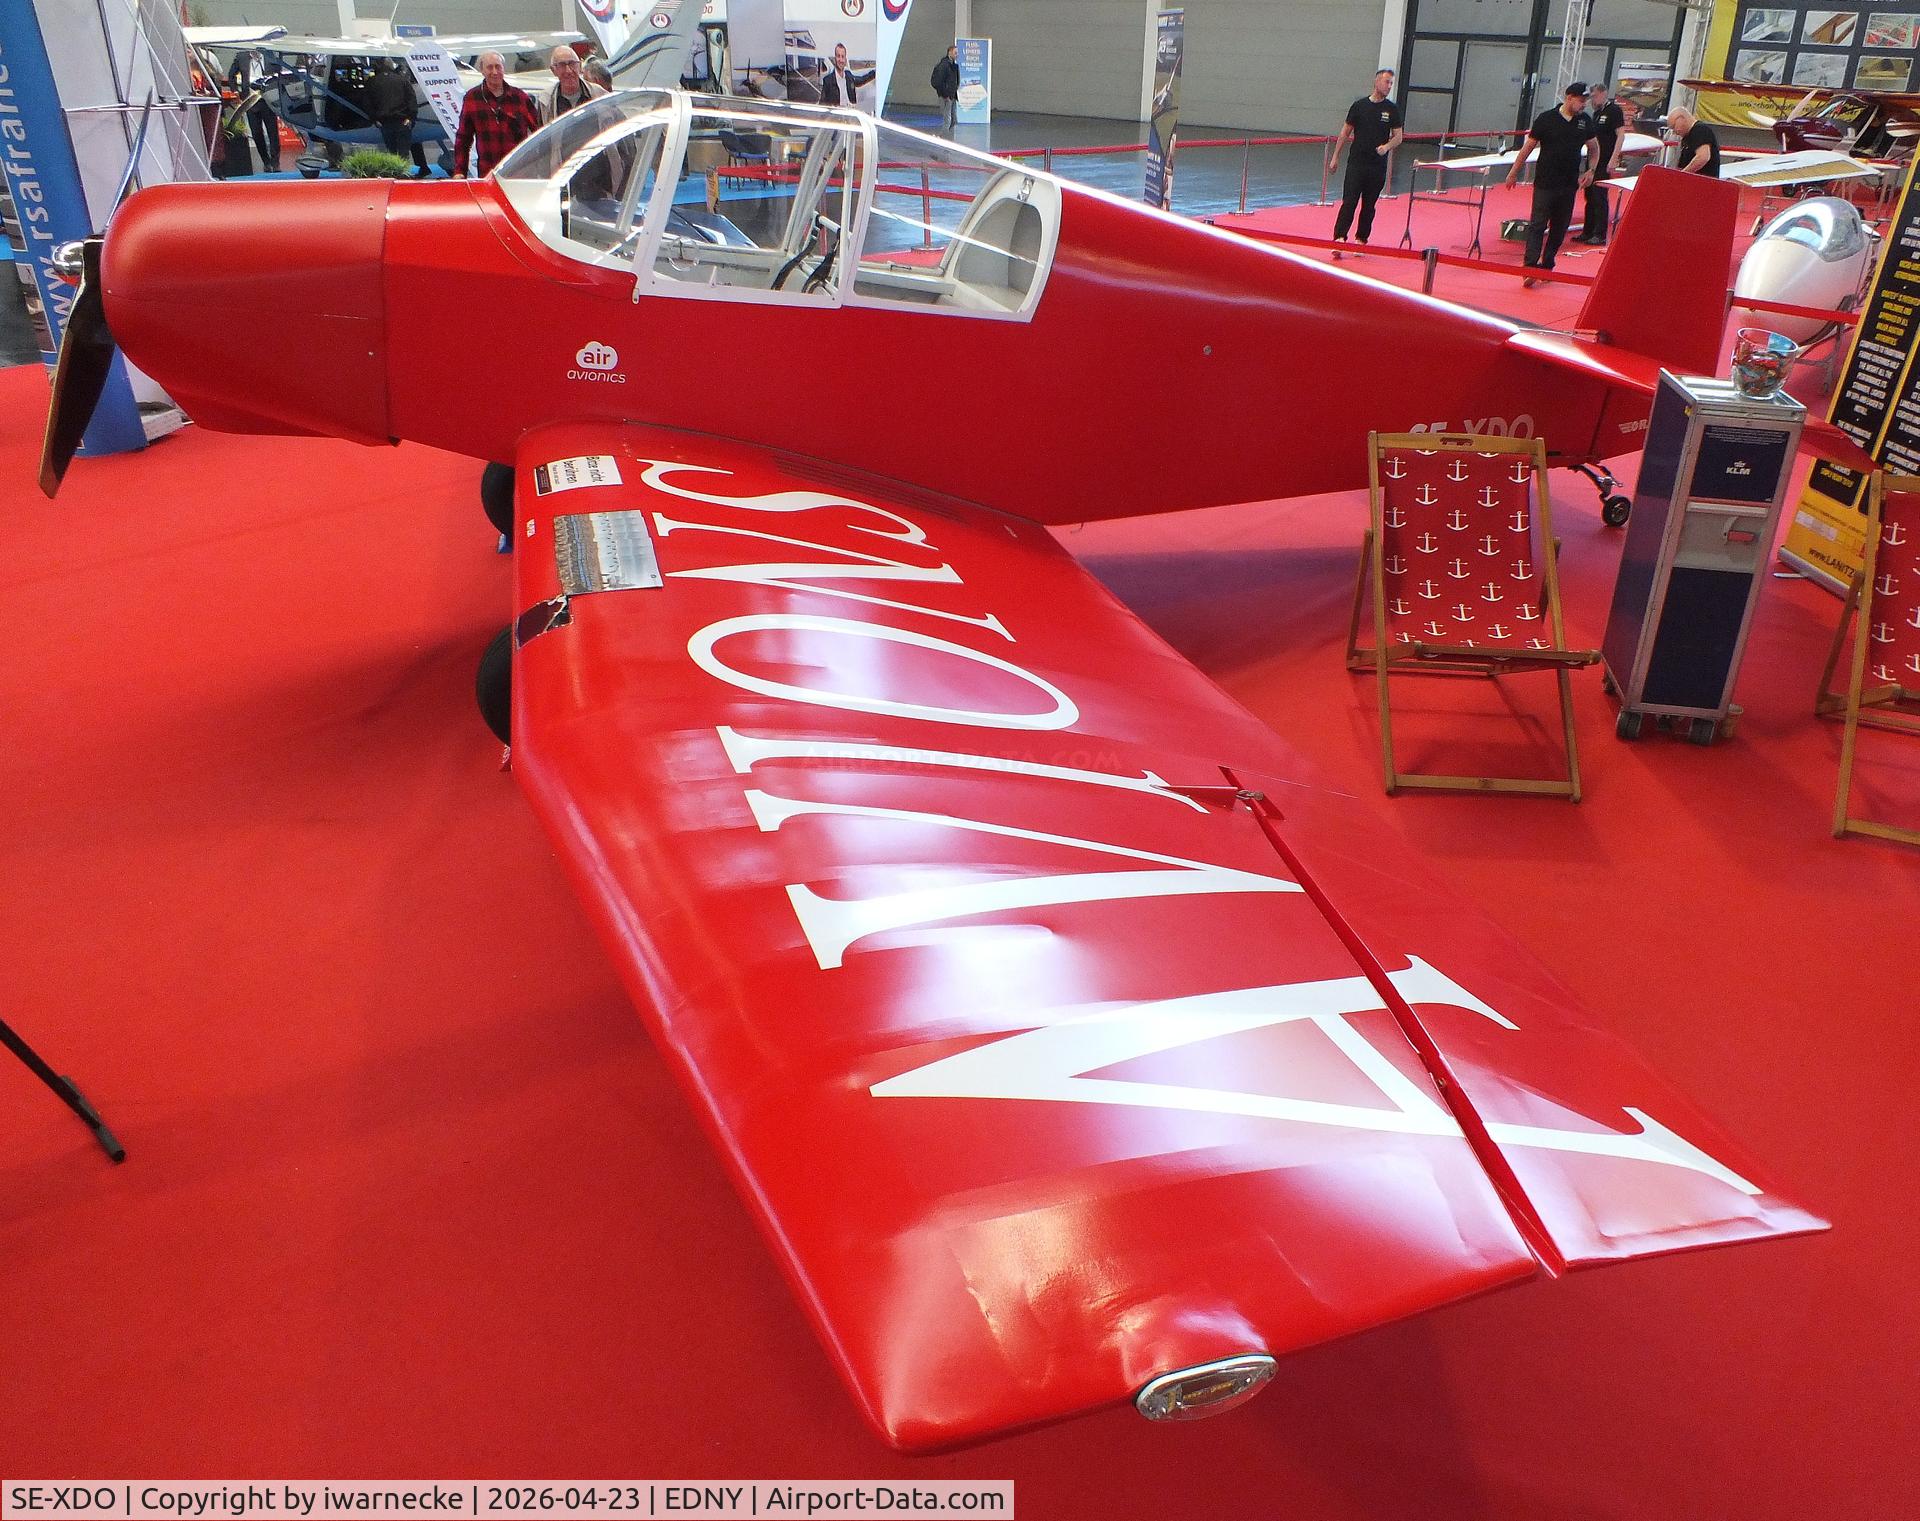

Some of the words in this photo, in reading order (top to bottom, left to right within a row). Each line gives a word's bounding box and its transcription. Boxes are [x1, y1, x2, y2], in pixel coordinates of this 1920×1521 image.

[583, 348, 610, 365] air
[567, 369, 626, 384] avionics
[1726, 467, 1751, 475] KLM
[636, 457, 1764, 1195] AVIONS
